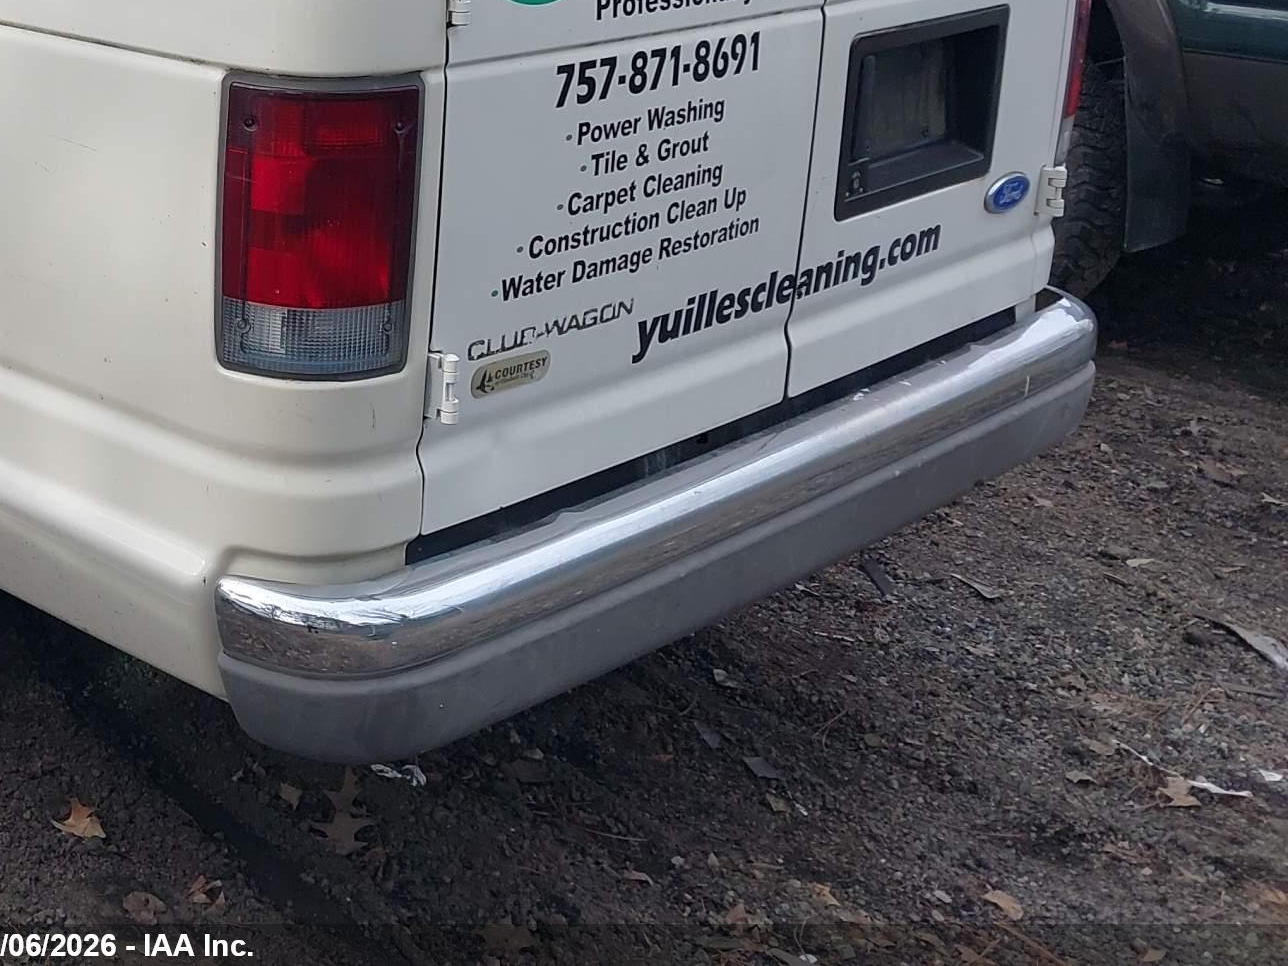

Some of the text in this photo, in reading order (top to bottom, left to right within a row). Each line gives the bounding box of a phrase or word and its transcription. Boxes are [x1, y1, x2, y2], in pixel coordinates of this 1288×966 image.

[554, 32, 761, 109] 757-871-8691
[576, 97, 725, 146] Power Washing
[591, 132, 710, 177] Tile & Grout
[567, 162, 724, 216] Carpet Cleaning
[529, 186, 747, 260] Construction Clean Up
[501, 215, 760, 302] Water Damage Restoration
[631, 224, 942, 364] yuillescleaning.com
[495, 357, 548, 379] COURTESY
